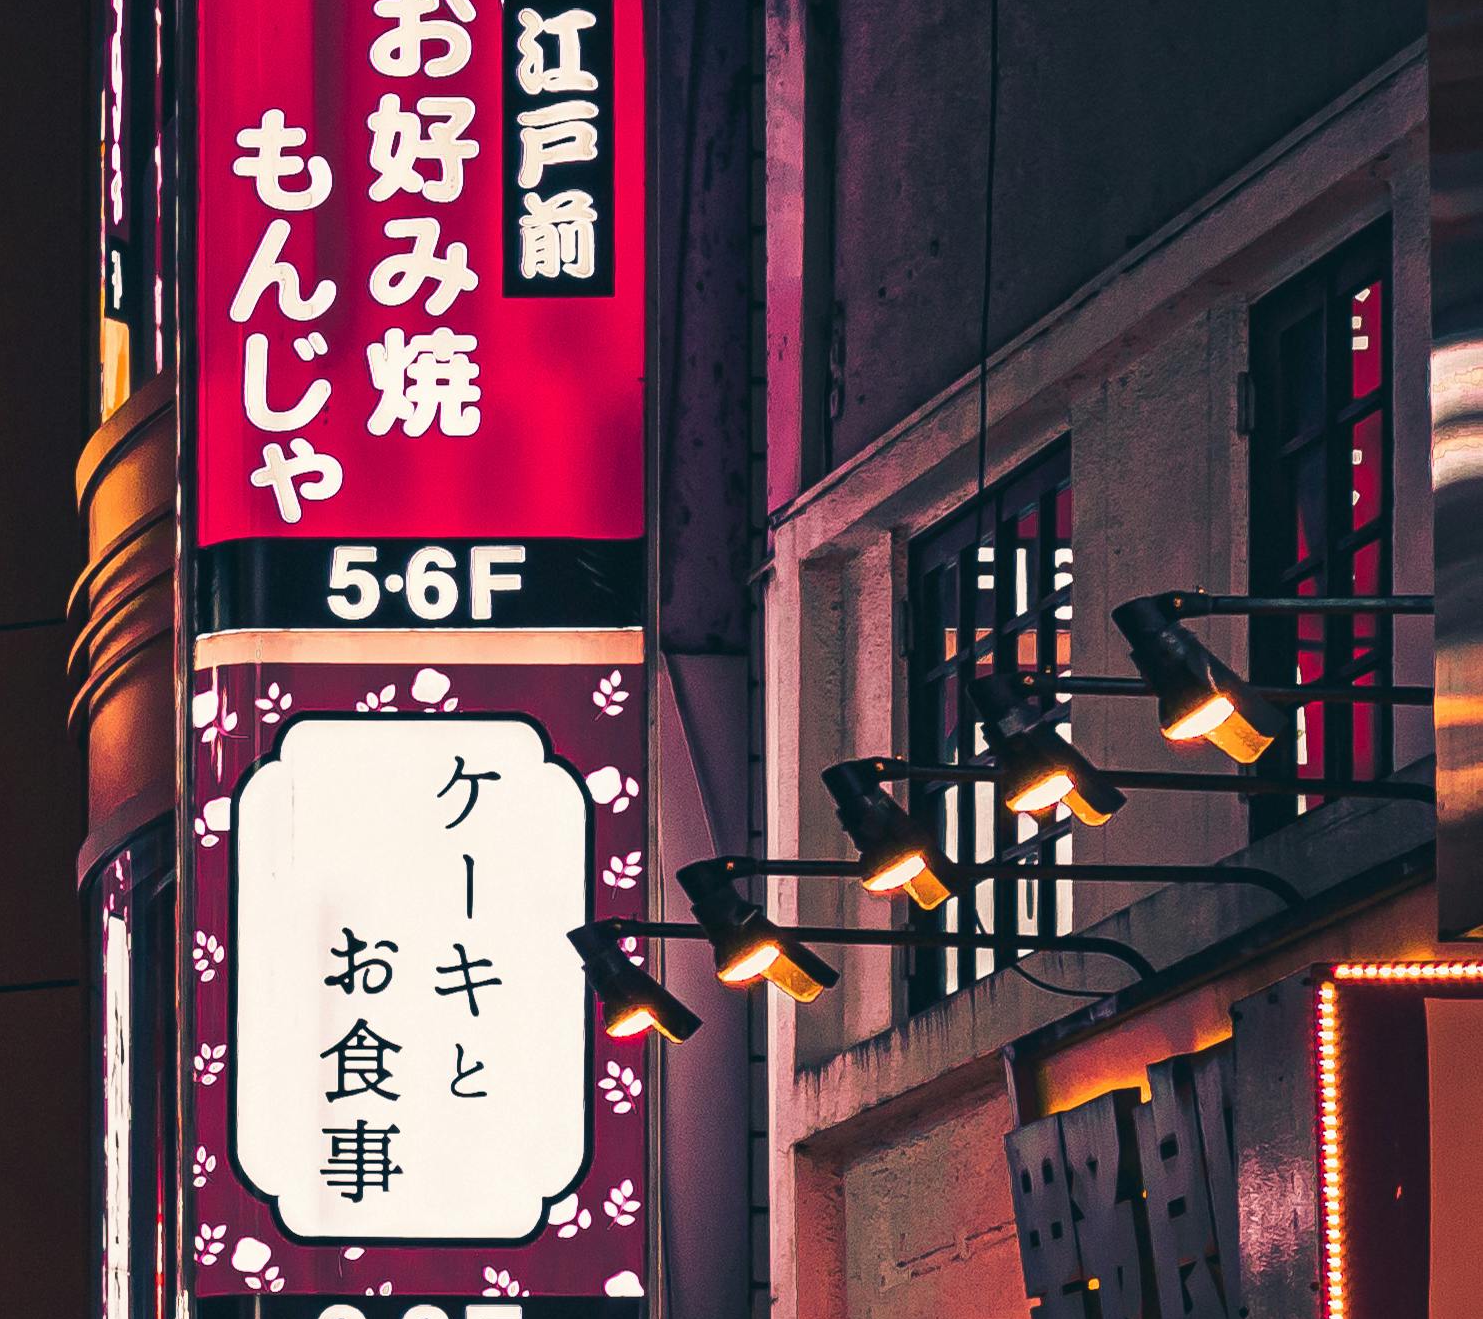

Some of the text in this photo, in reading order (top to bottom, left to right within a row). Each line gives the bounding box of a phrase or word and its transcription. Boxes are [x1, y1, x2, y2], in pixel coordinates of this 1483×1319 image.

[517, 8, 600, 280] 江戸前
[229, 108, 344, 525] もんじゃ
[319, 926, 404, 1204] お食事
[434, 755, 504, 1100] ケーキと
